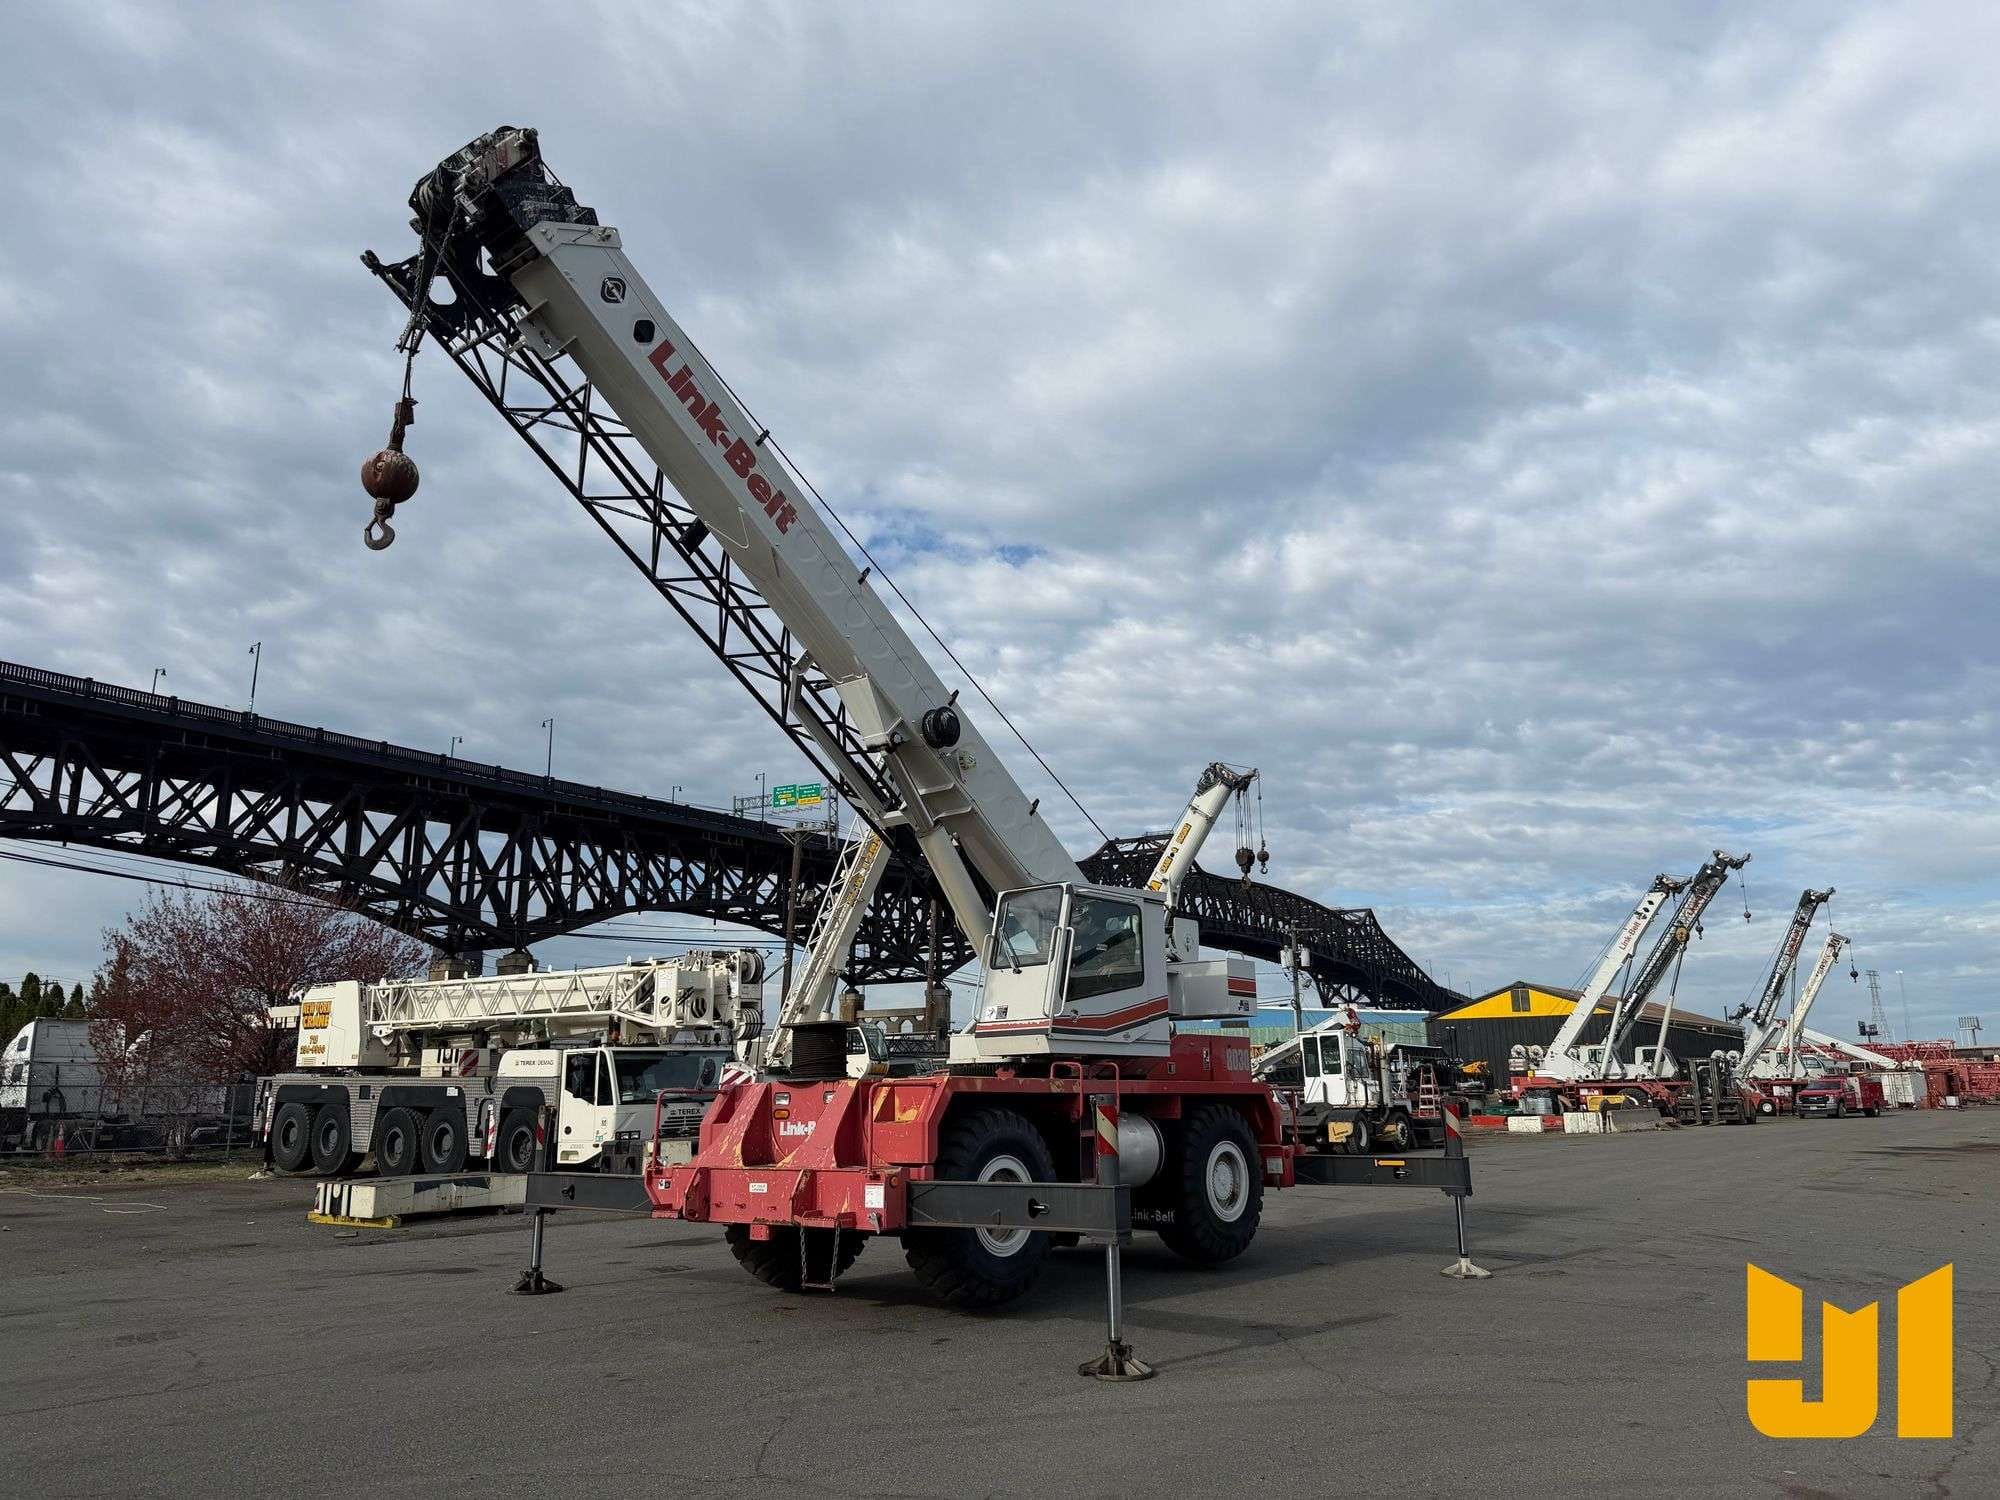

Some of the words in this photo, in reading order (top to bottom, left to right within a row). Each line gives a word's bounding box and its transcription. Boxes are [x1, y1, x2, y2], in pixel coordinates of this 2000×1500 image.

[648, 339, 798, 536] Link-Belt
[1619, 921, 1642, 950] Link-Belt
[1132, 1208, 1175, 1223] ink-Belt
